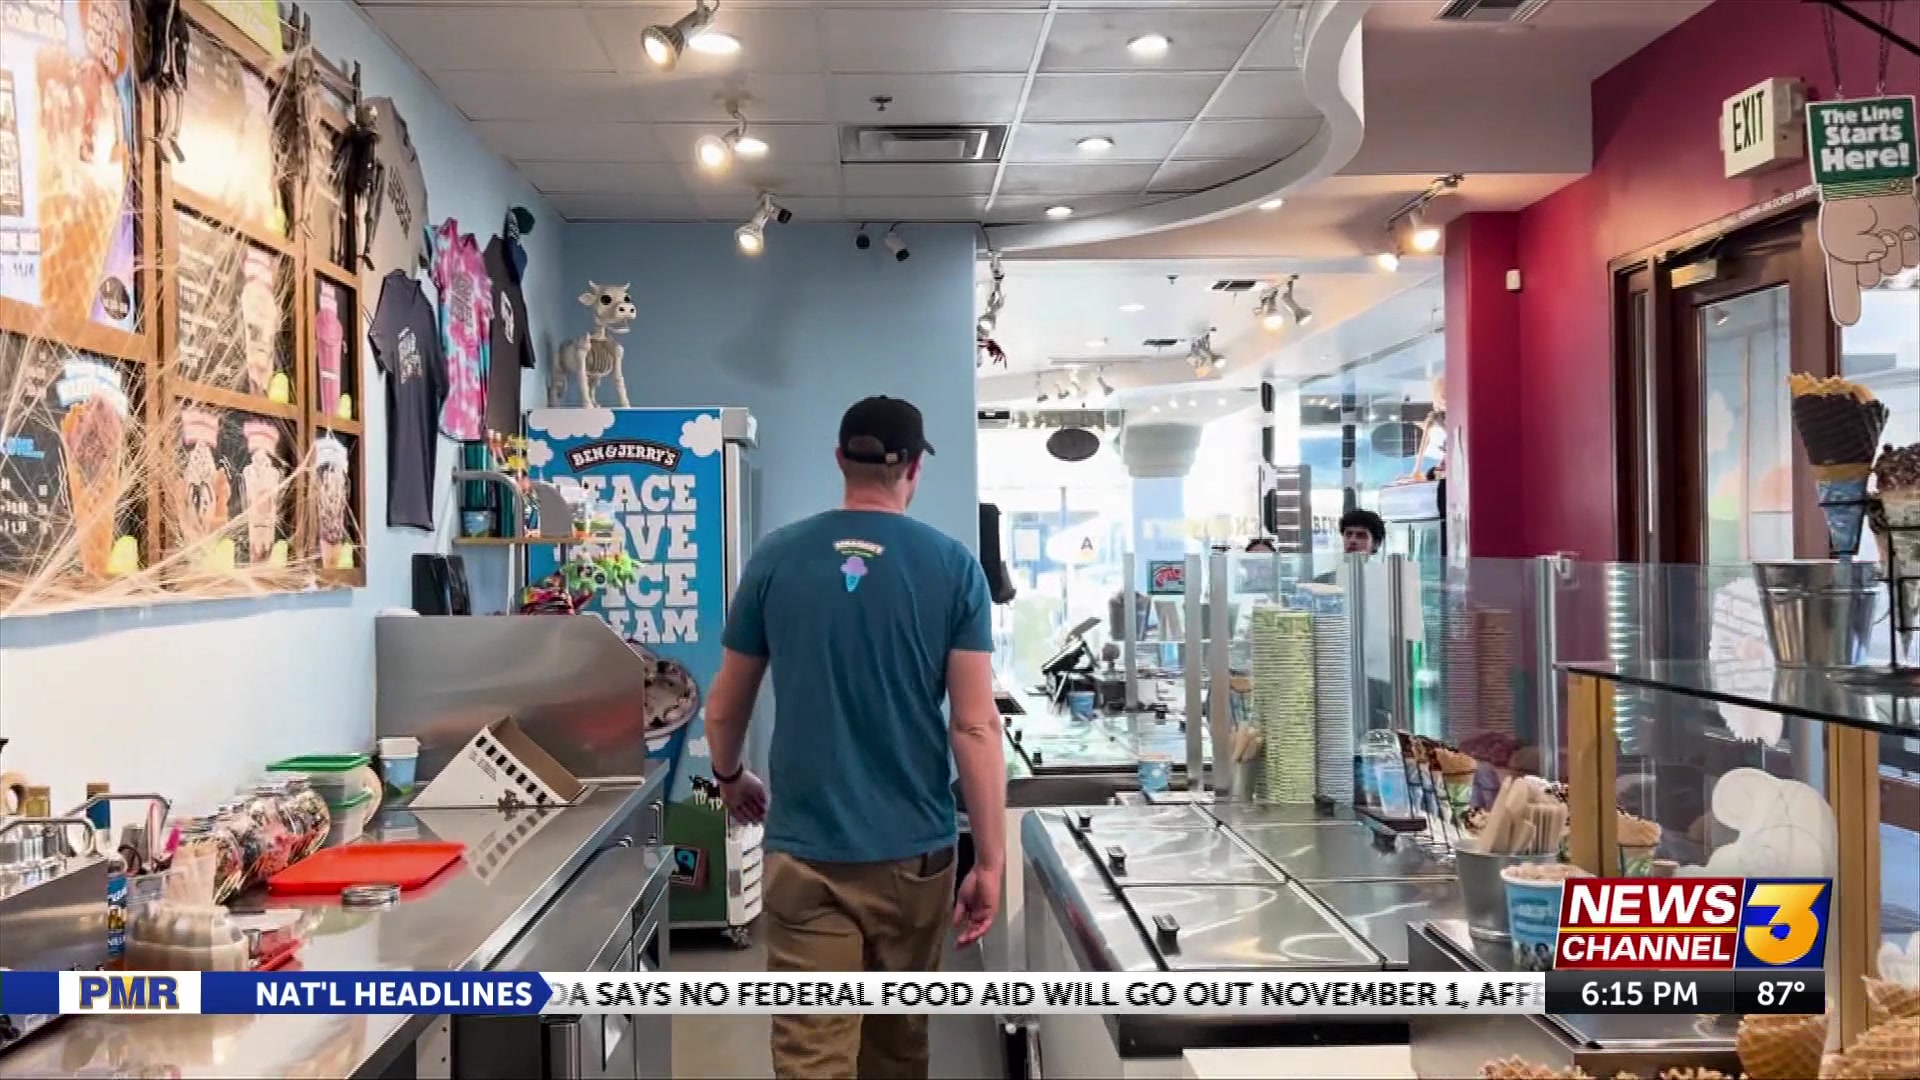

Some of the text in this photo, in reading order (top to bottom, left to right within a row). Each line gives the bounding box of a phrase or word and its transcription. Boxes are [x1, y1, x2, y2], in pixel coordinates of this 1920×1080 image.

[1733, 90, 1764, 152] EXIT
[1821, 106, 1904, 125] The Line
[1825, 122, 1903, 145] Starts
[1821, 142, 1910, 172] Here!
[1081, 536, 1093, 550] A
